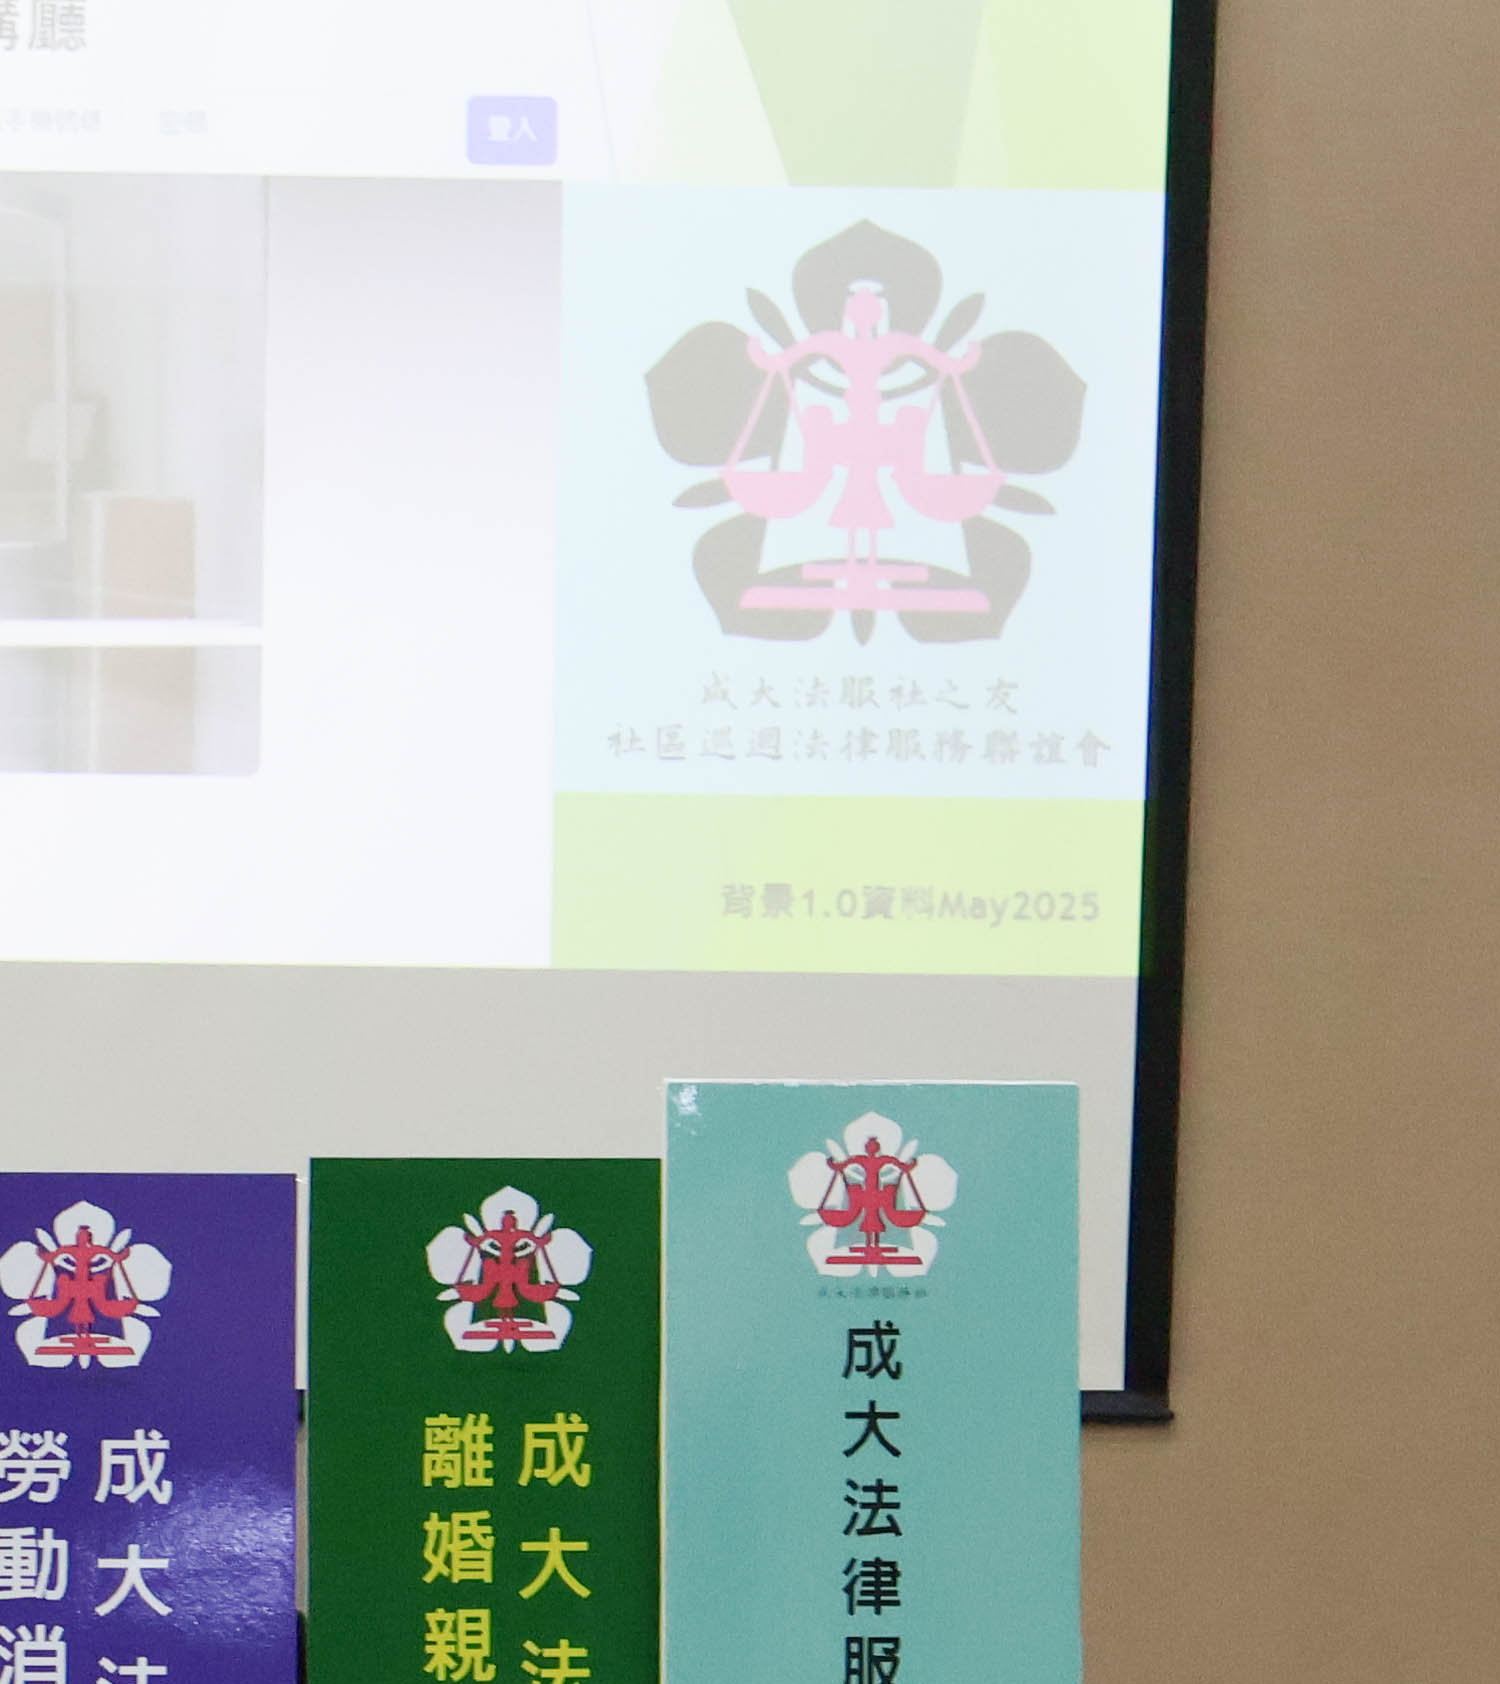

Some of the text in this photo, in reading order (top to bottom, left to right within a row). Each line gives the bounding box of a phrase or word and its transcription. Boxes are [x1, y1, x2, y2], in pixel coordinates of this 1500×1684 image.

[699, 670, 1021, 716] 成大法服社之友
[719, 881, 1101, 928] 背景1.0資料May2025
